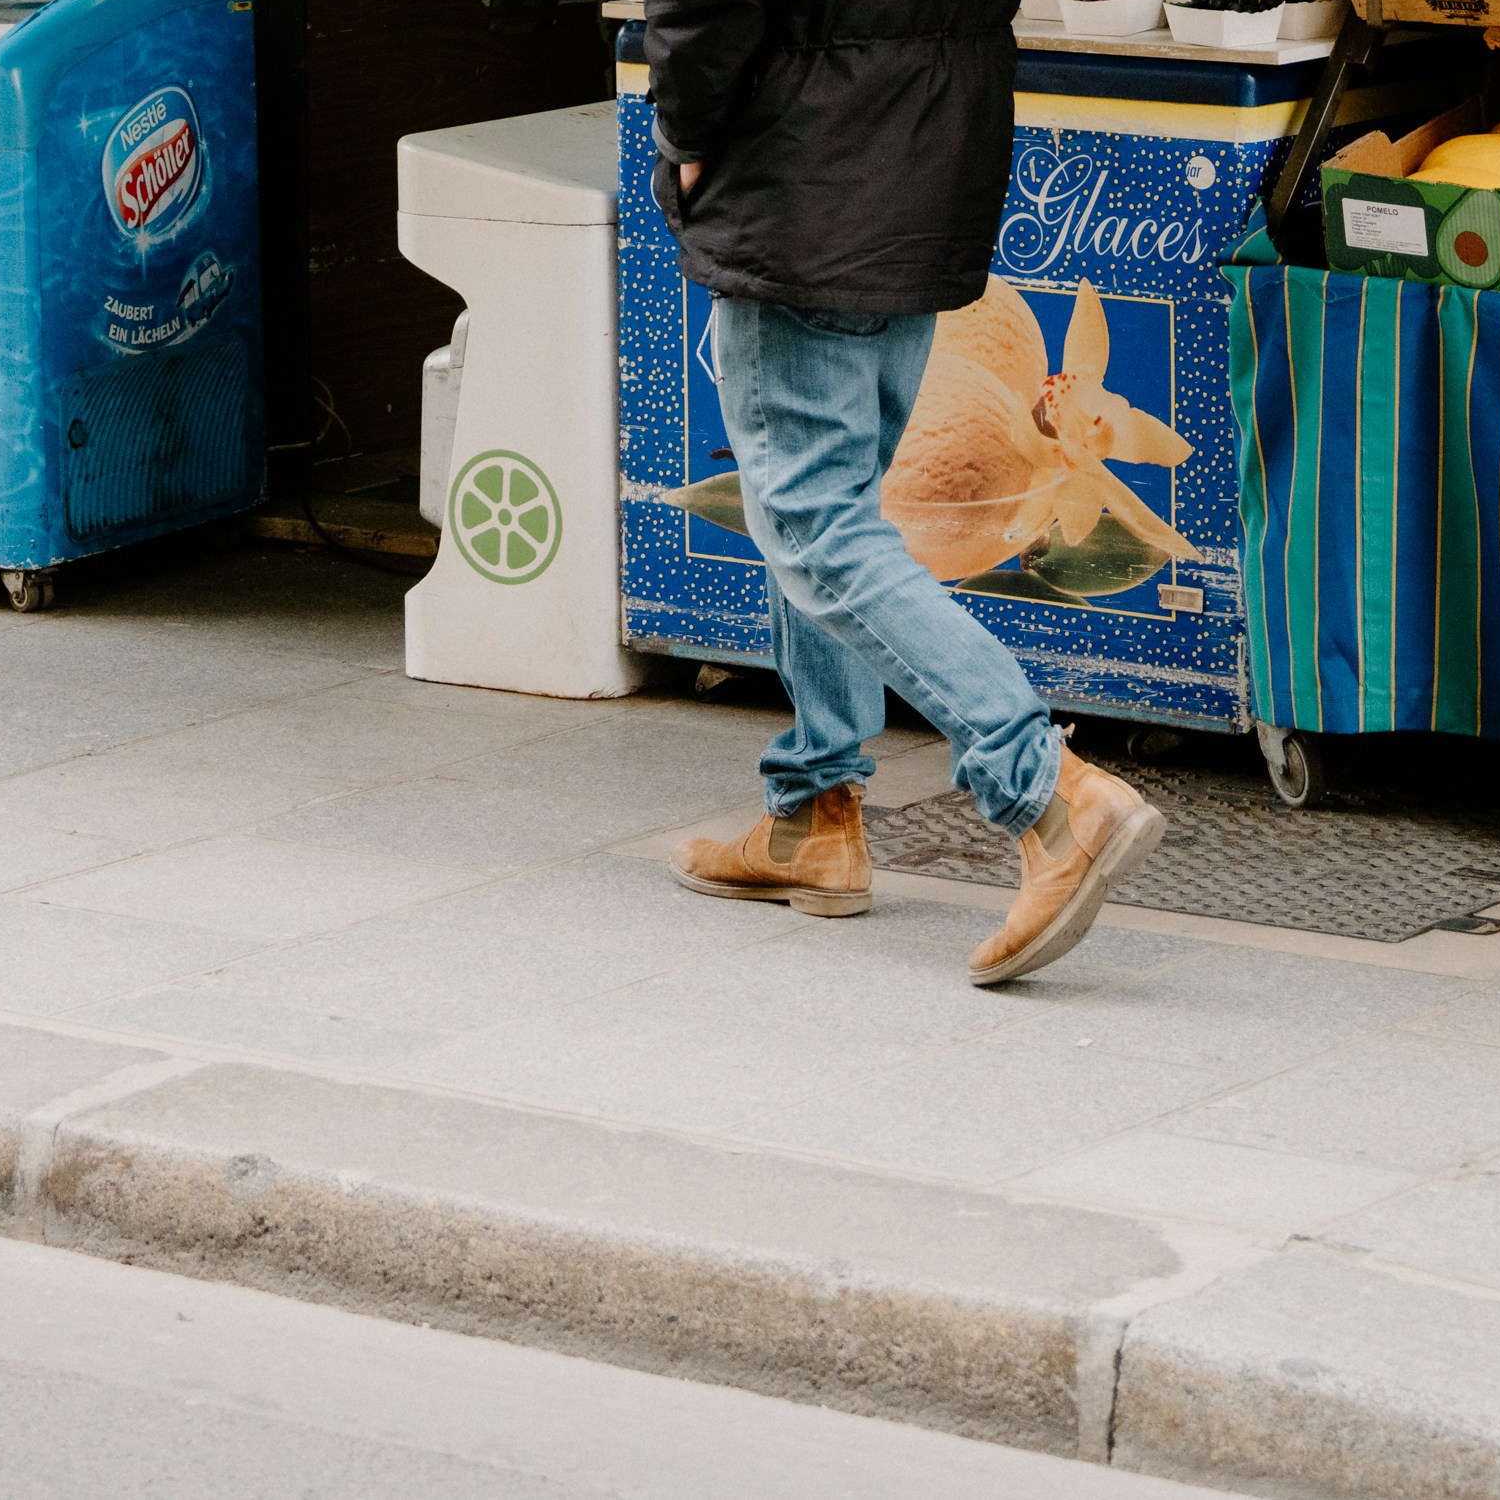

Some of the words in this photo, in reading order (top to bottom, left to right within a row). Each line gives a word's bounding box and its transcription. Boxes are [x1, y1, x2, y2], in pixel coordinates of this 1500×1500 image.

[1442, 0, 1483, 10] BRIO
[120, 98, 167, 152] Nestlé
[120, 128, 192, 229] Schöller
[999, 146, 1208, 274] Glaces
[1366, 205, 1399, 216] POMELO
[104, 295, 154, 322] ZAUBERT
[109, 323, 127, 343] EIN
[131, 316, 182, 345] LÄCHELN
